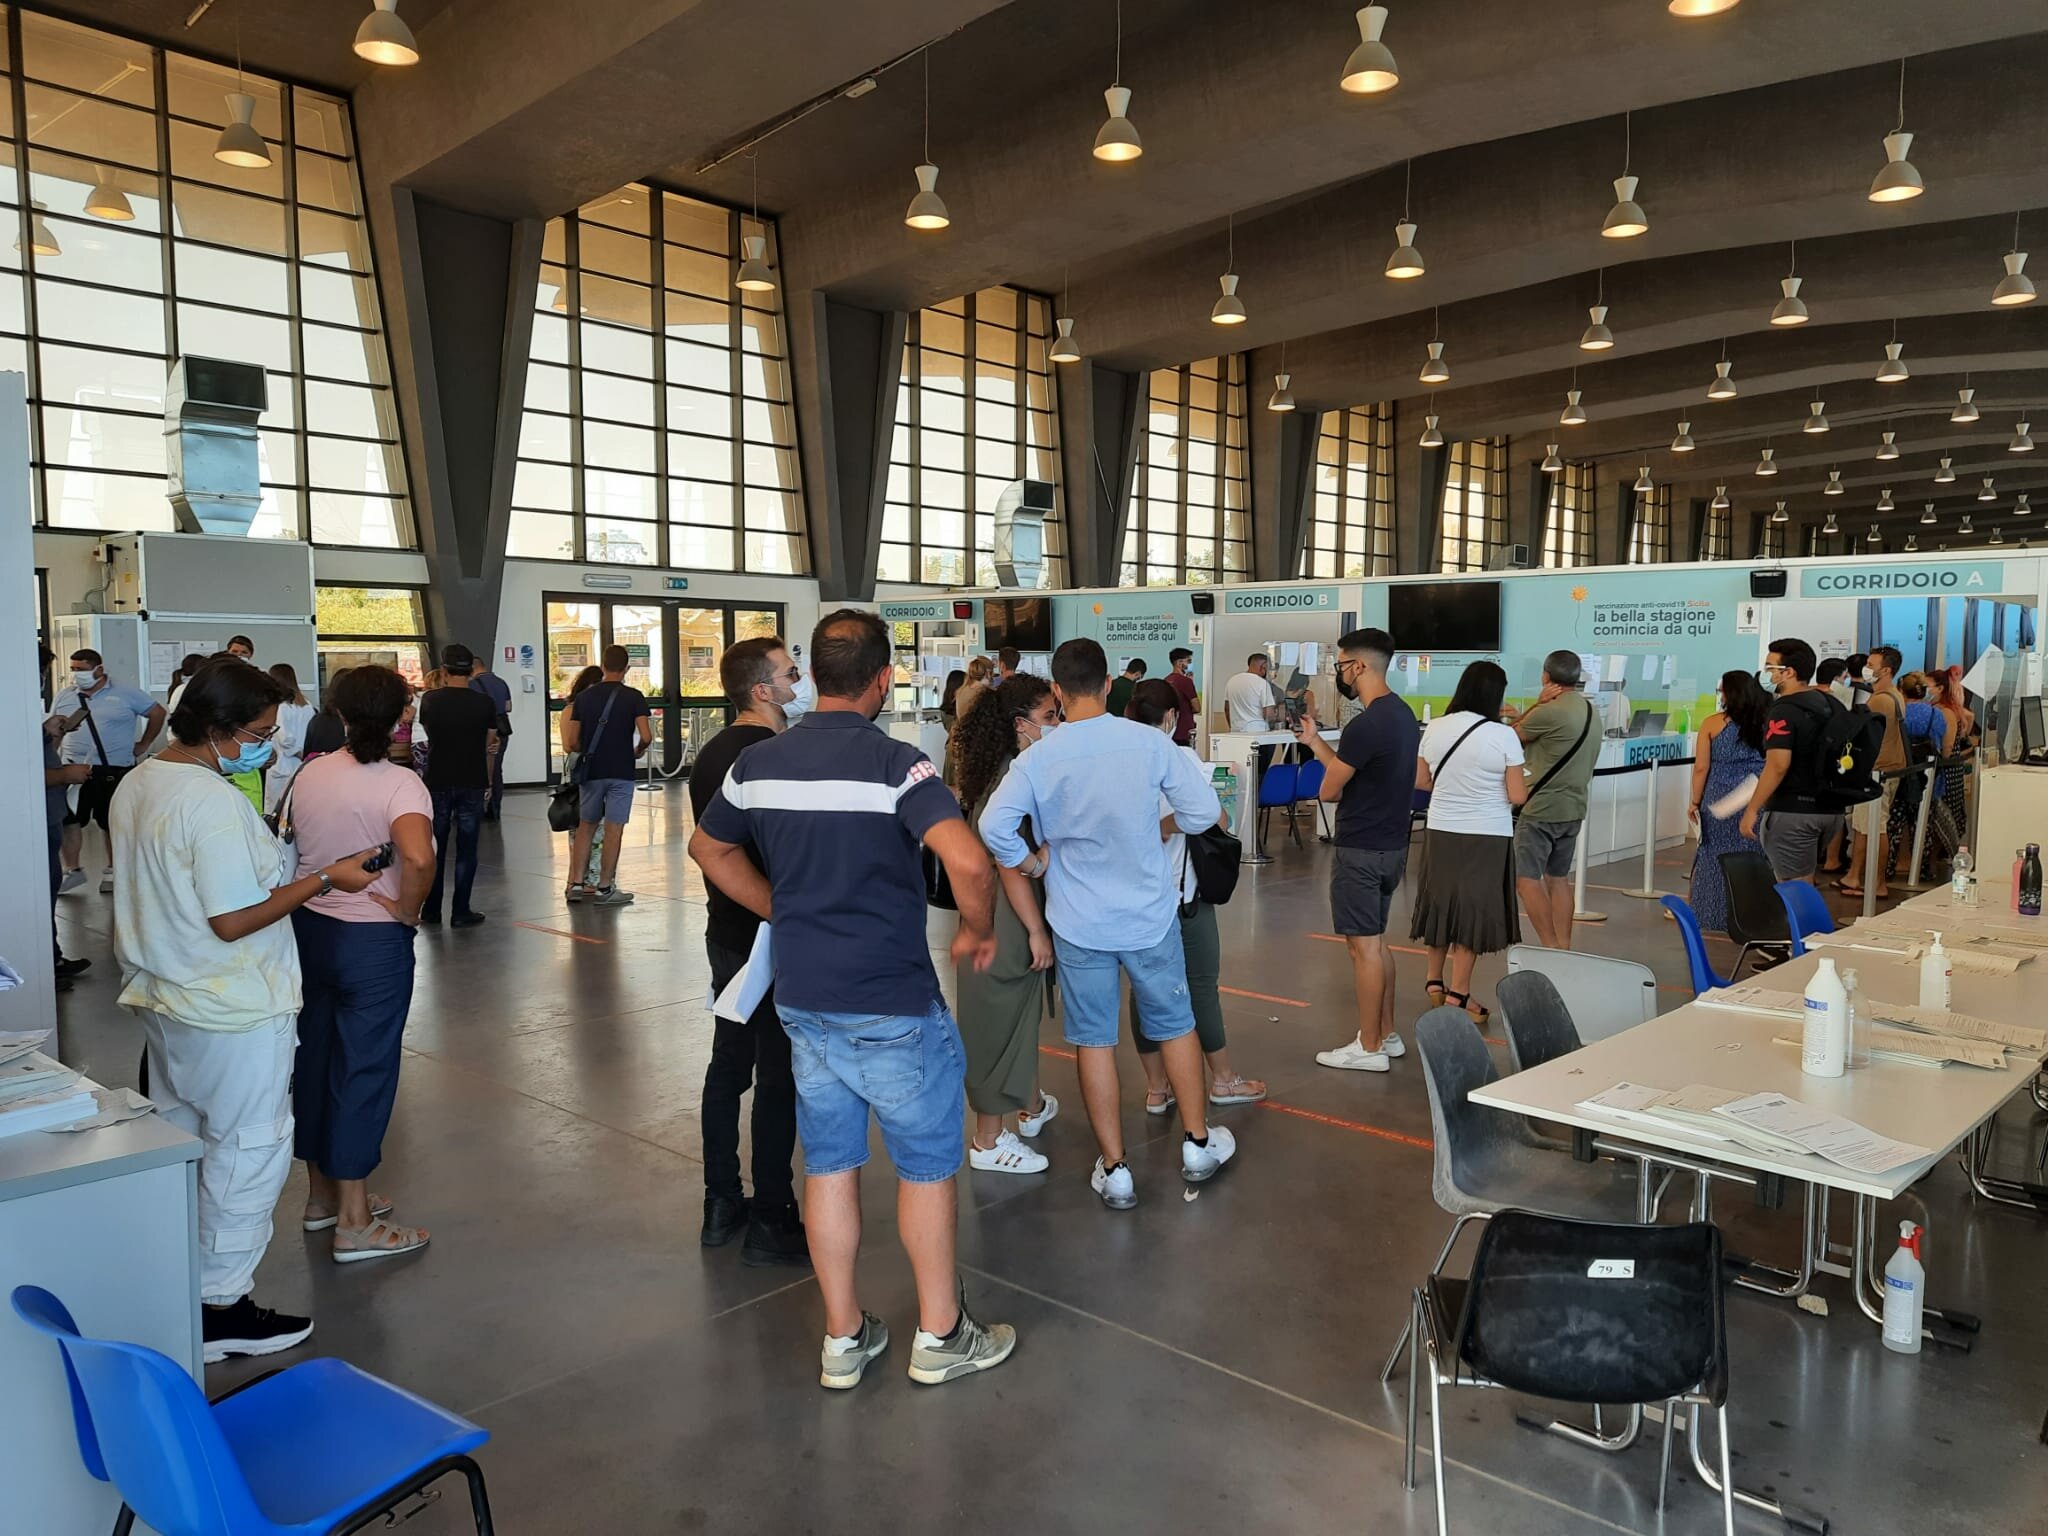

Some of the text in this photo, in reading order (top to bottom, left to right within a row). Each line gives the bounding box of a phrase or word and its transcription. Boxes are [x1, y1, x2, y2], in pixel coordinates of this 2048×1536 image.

[1817, 571, 1984, 590] CORRIDOIO A
[1234, 594, 1328, 608] CORRIDOIO B
[885, 606, 944, 617] CORRIDOIO C
[1593, 609, 1716, 624] la bella stagione
[1106, 621, 1178, 632] la bella stagione
[1593, 622, 1712, 637] comincia da qui
[1106, 630, 1176, 642] comincia da qui
[1629, 742, 1682, 766] RECEPTION
[1597, 1265, 1631, 1274] 79 S
